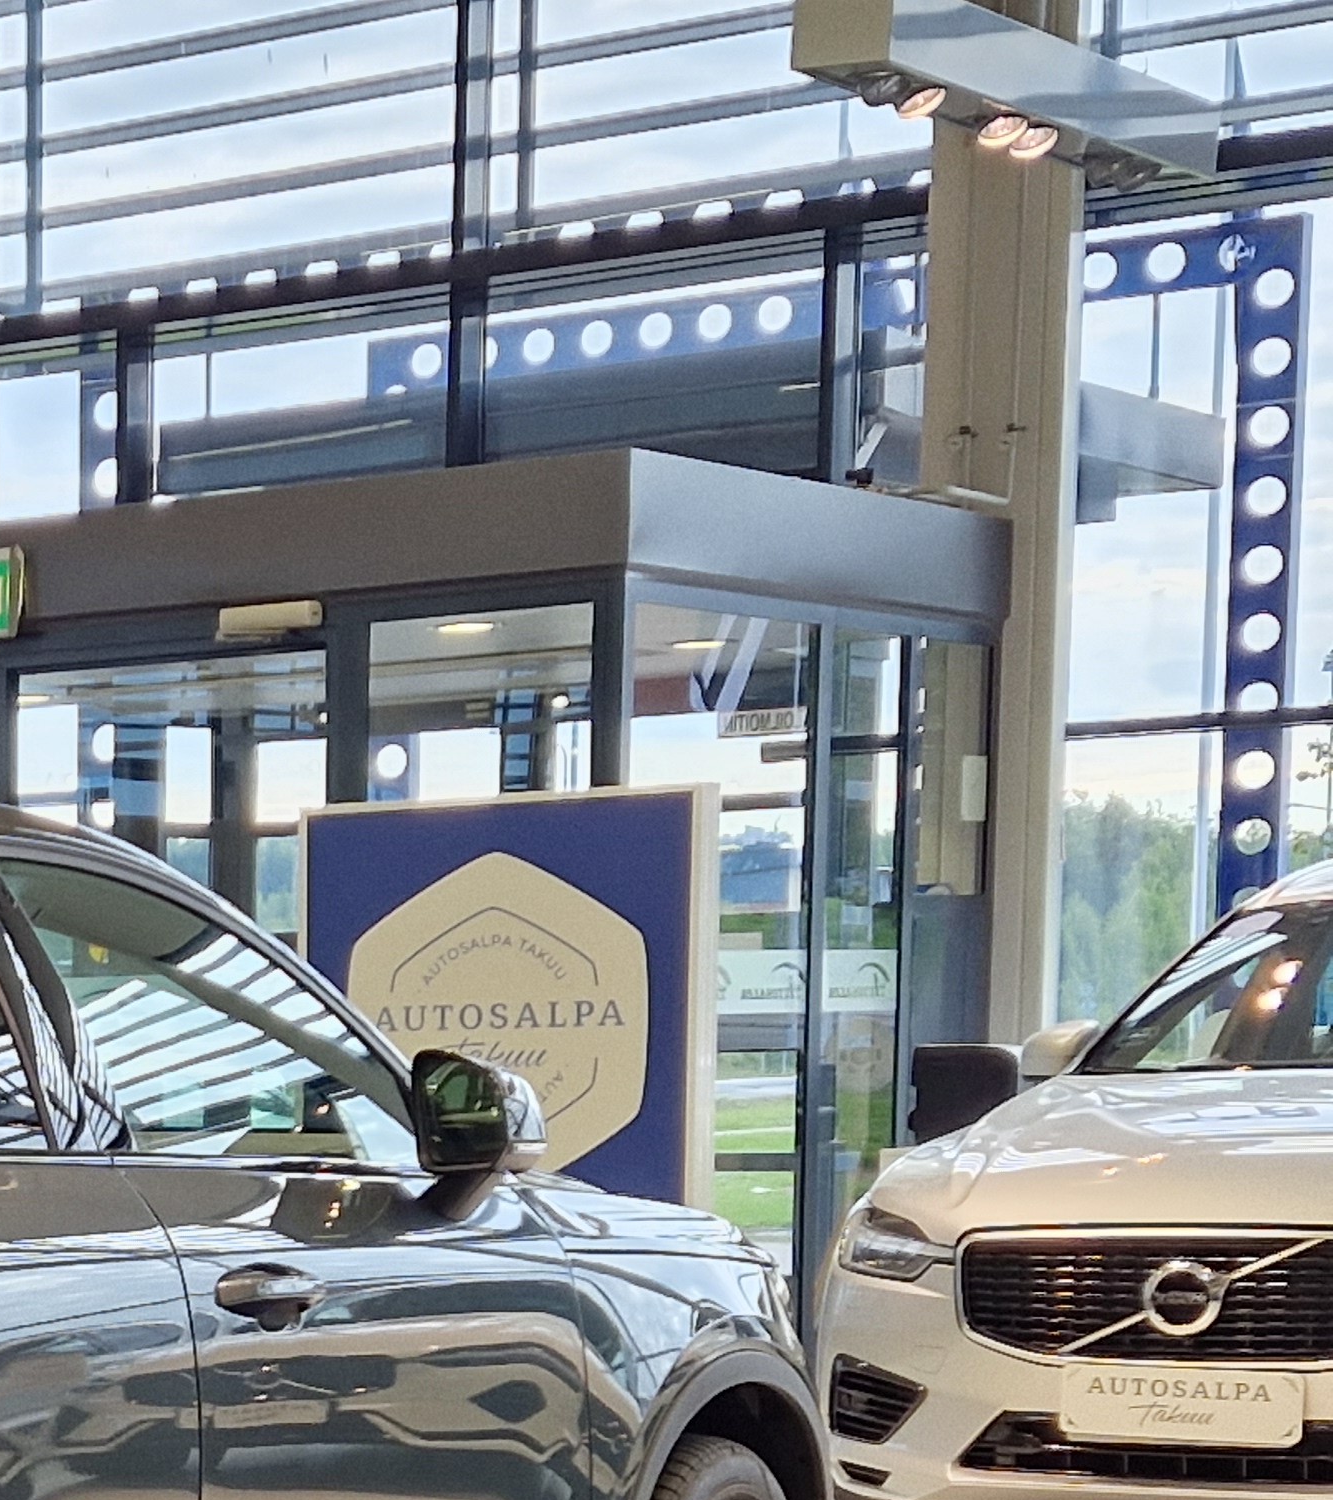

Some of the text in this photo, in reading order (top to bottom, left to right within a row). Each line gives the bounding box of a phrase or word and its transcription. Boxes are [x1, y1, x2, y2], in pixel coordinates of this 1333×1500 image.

[423, 934, 568, 986] AUTOSALPA TAKUU
[376, 999, 626, 1033] AUTOSALPA
[1087, 1376, 1272, 1402] AUTOSALPA
[1128, 1401, 1216, 1428] Takuu
